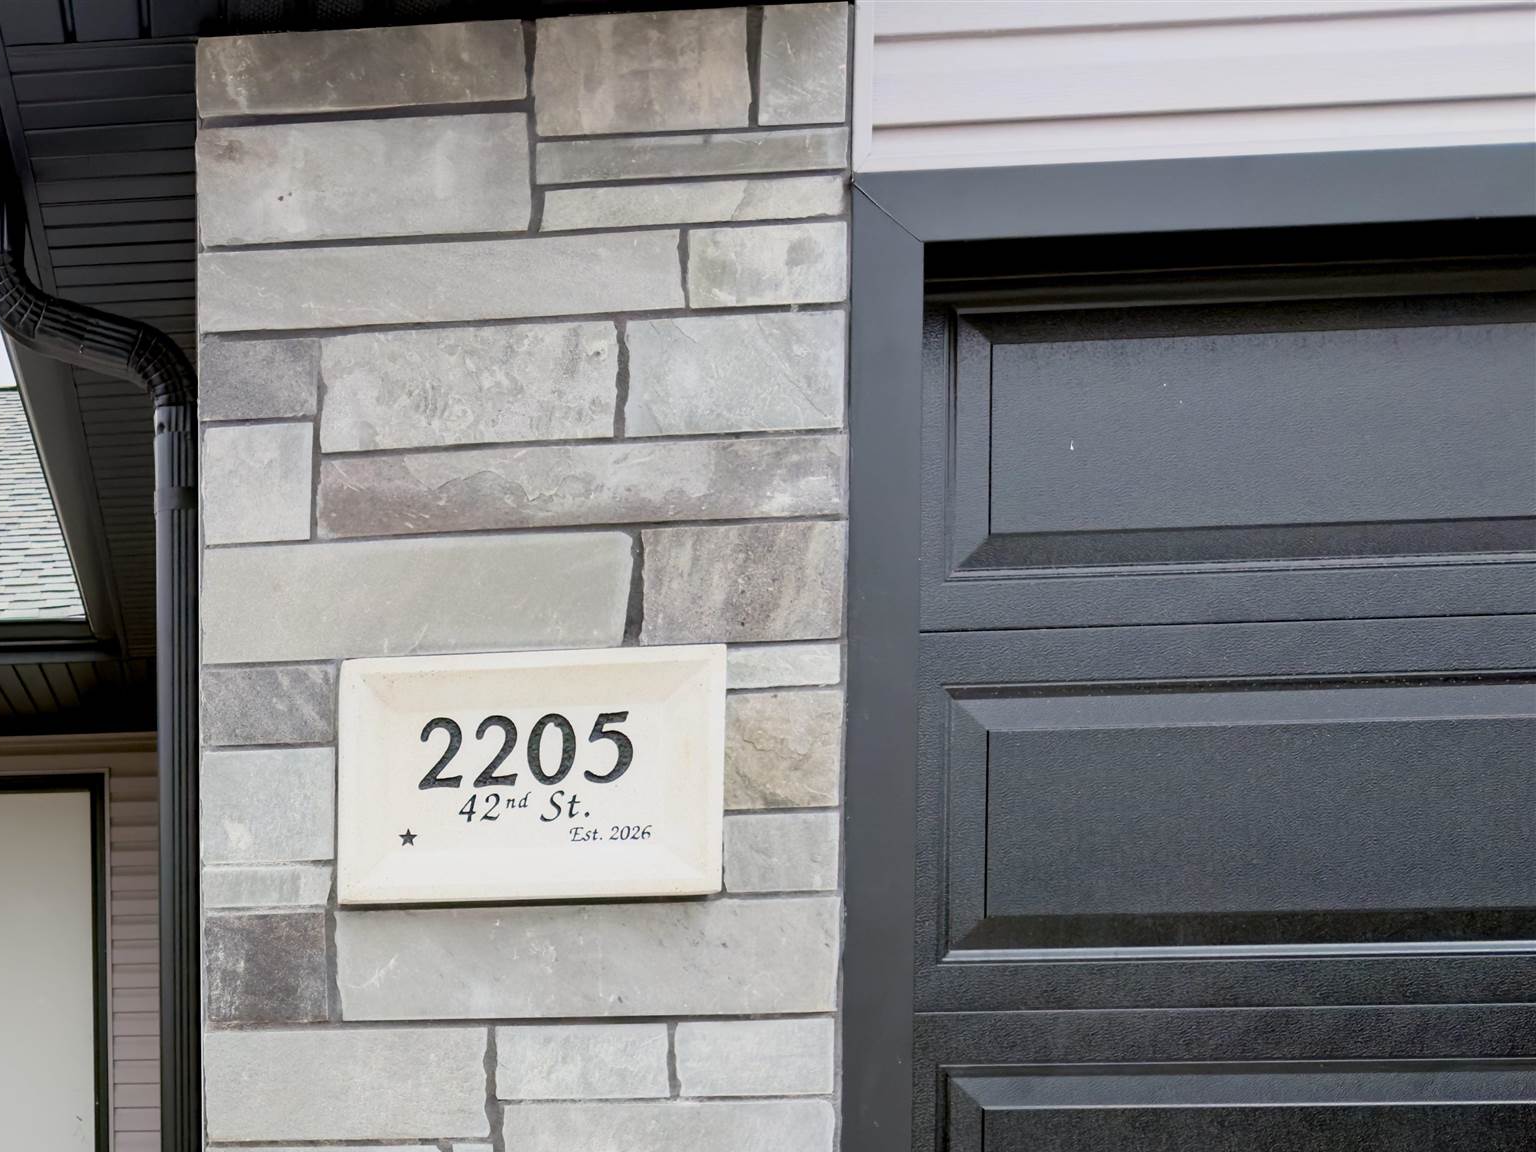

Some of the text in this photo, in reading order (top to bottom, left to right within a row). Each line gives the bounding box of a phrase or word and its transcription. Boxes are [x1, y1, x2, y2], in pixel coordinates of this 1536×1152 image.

[417, 710, 634, 791] 2205
[458, 789, 591, 823] 42nd St.
[569, 824, 652, 842] Est. 2026
